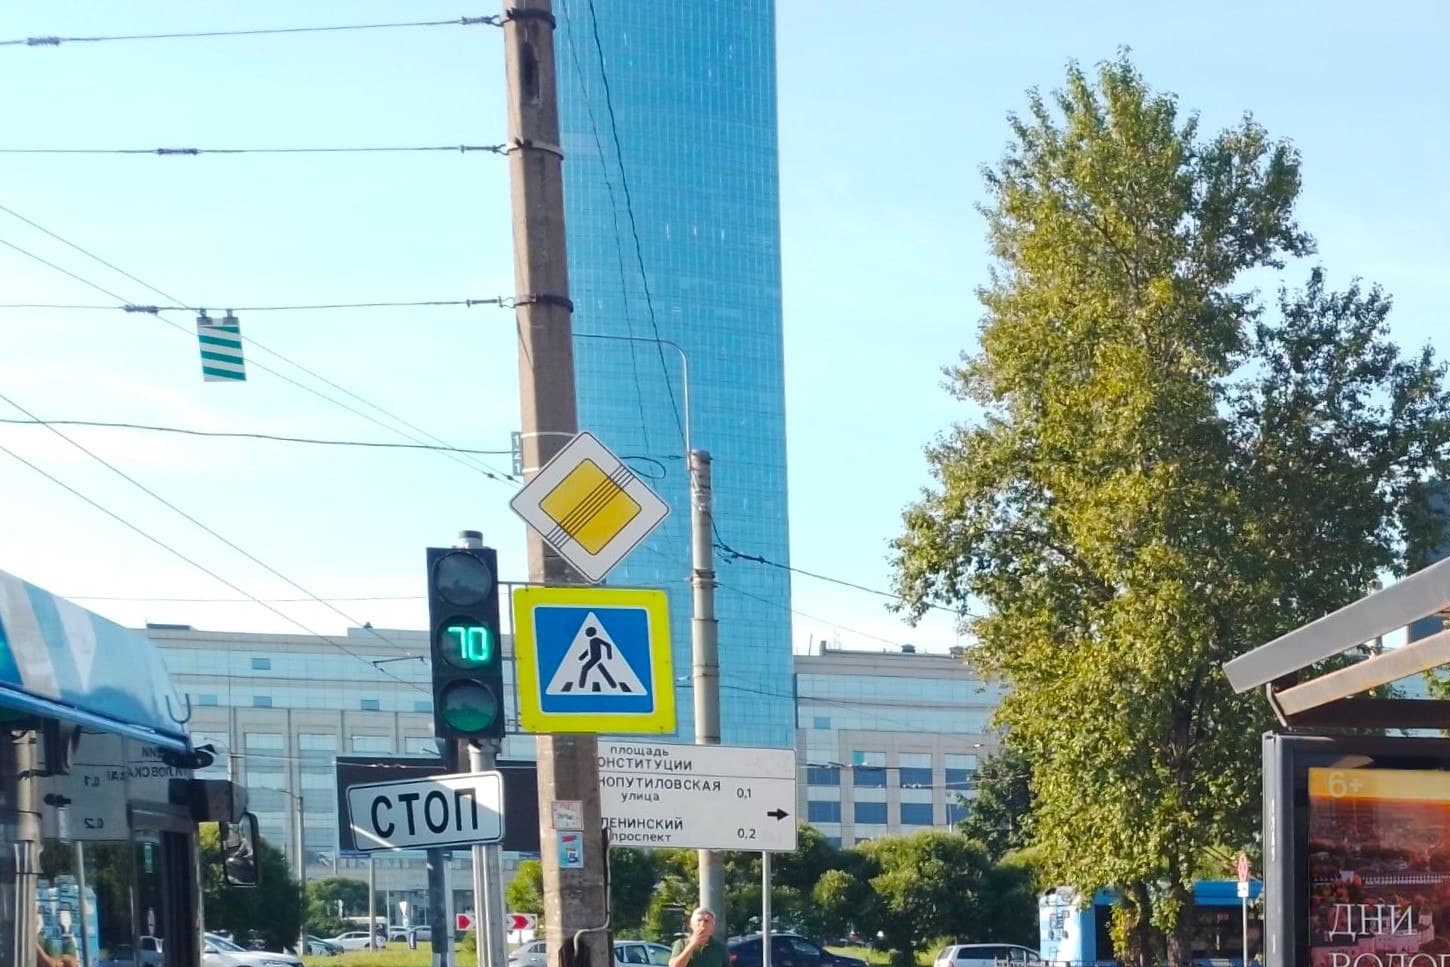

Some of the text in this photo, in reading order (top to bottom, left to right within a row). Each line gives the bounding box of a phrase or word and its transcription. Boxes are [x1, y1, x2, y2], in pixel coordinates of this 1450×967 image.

[447, 626, 488, 661] 70
[610, 746, 669, 757] площадь
[598, 757, 692, 771] ОНСТИТУЦИИ
[599, 776, 721, 792] НОПУТИЛОВСКАЯ
[1329, 771, 1362, 798] 6+
[621, 792, 660, 803] улица
[371, 787, 479, 839] СТОП
[601, 817, 683, 831] ЛЕНИНСКИЙ
[611, 831, 672, 843] проспект
[1328, 903, 1417, 942] ДНИ
